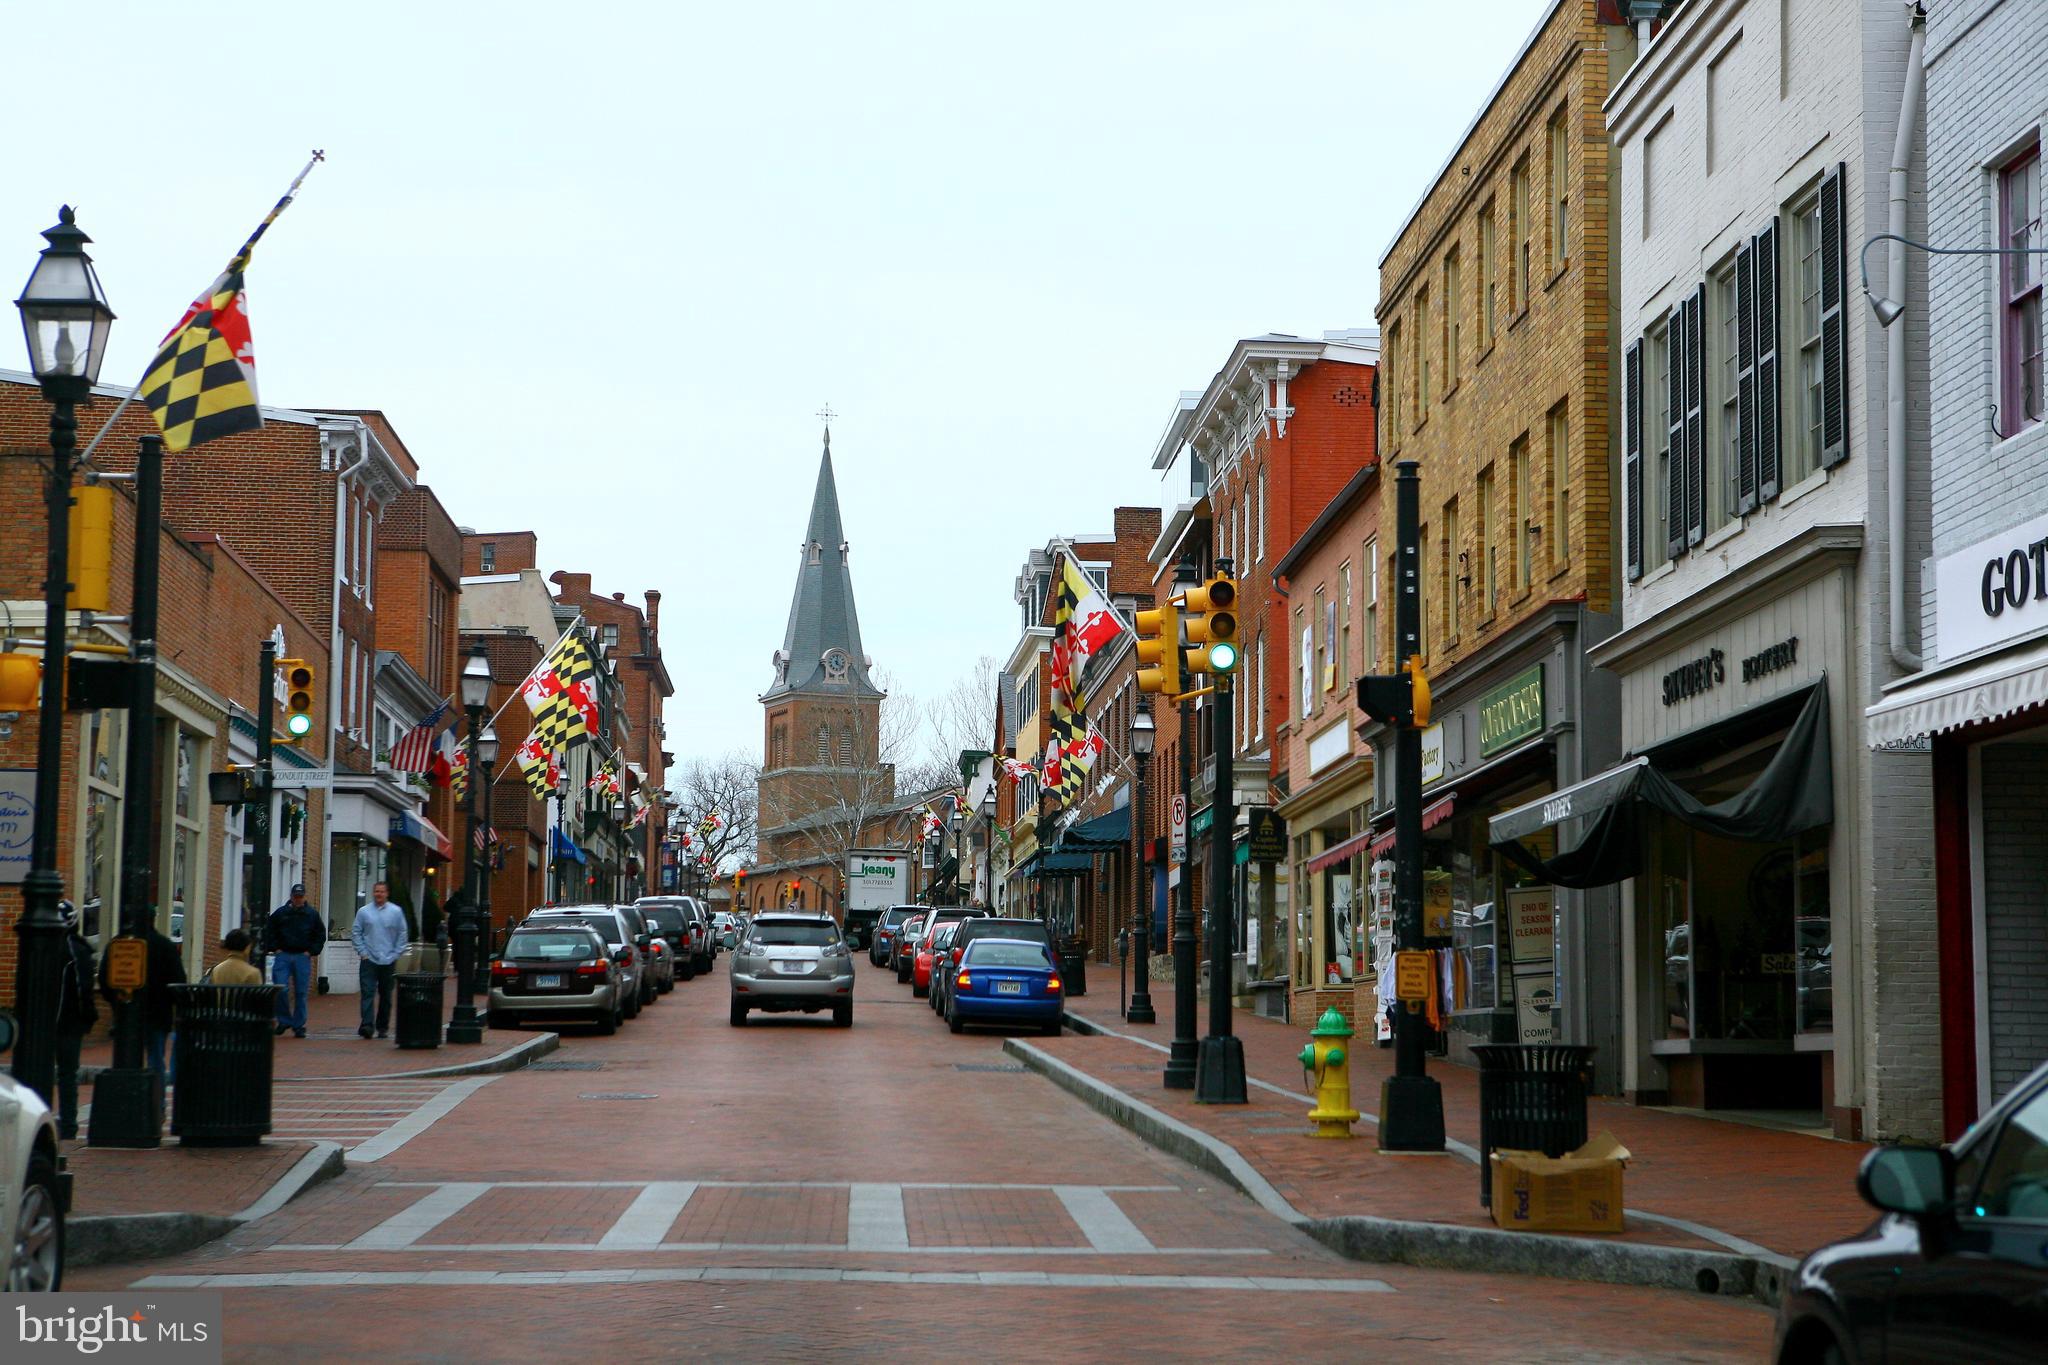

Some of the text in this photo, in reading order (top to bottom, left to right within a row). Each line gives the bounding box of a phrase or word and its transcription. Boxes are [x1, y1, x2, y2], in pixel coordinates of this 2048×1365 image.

[1662, 636, 1799, 706] SNYDER'S BOOTERY
[274, 771, 329, 781] CONDUIT STREET
[1542, 794, 1572, 825] SNYDER'S
[1521, 901, 1549, 913] END OF
[1520, 914, 1552, 925] SEASON
[1524, 1028, 1552, 1038] COMF
